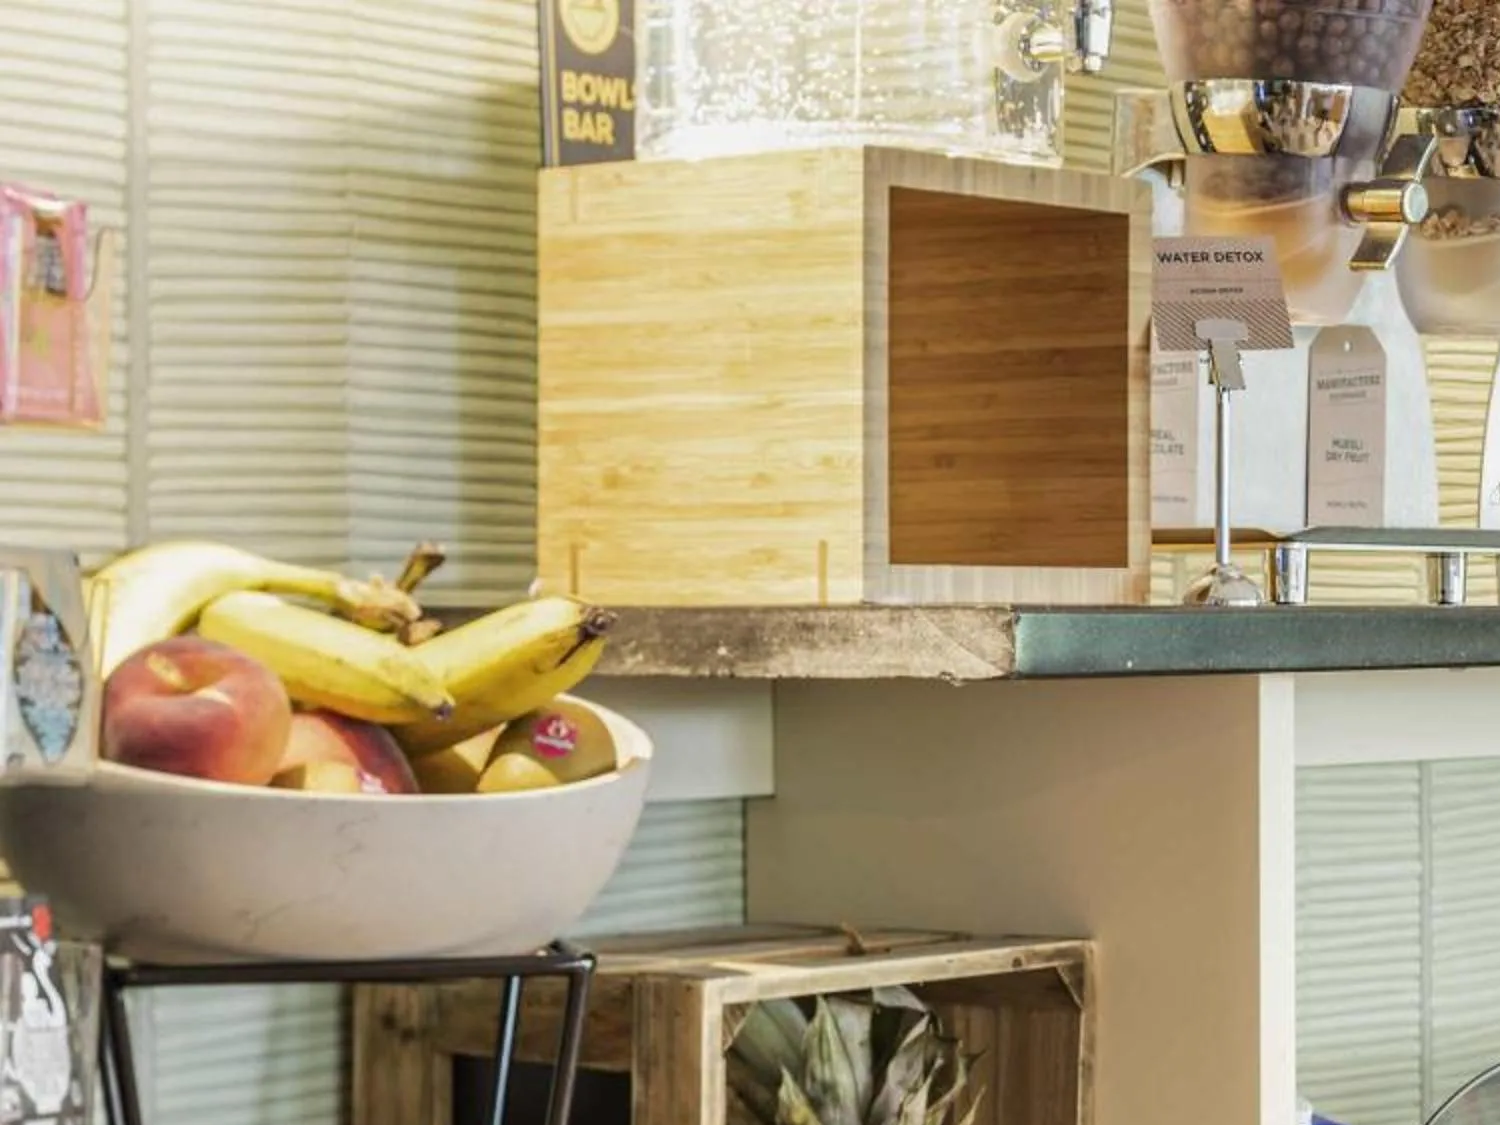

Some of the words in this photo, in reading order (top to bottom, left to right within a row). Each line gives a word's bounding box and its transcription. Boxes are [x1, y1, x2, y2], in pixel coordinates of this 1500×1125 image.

[561, 69, 636, 111] BOWL
[562, 107, 615, 145] BAR
[1157, 251, 1209, 263] WATER
[1213, 250, 1264, 263] DETOX
